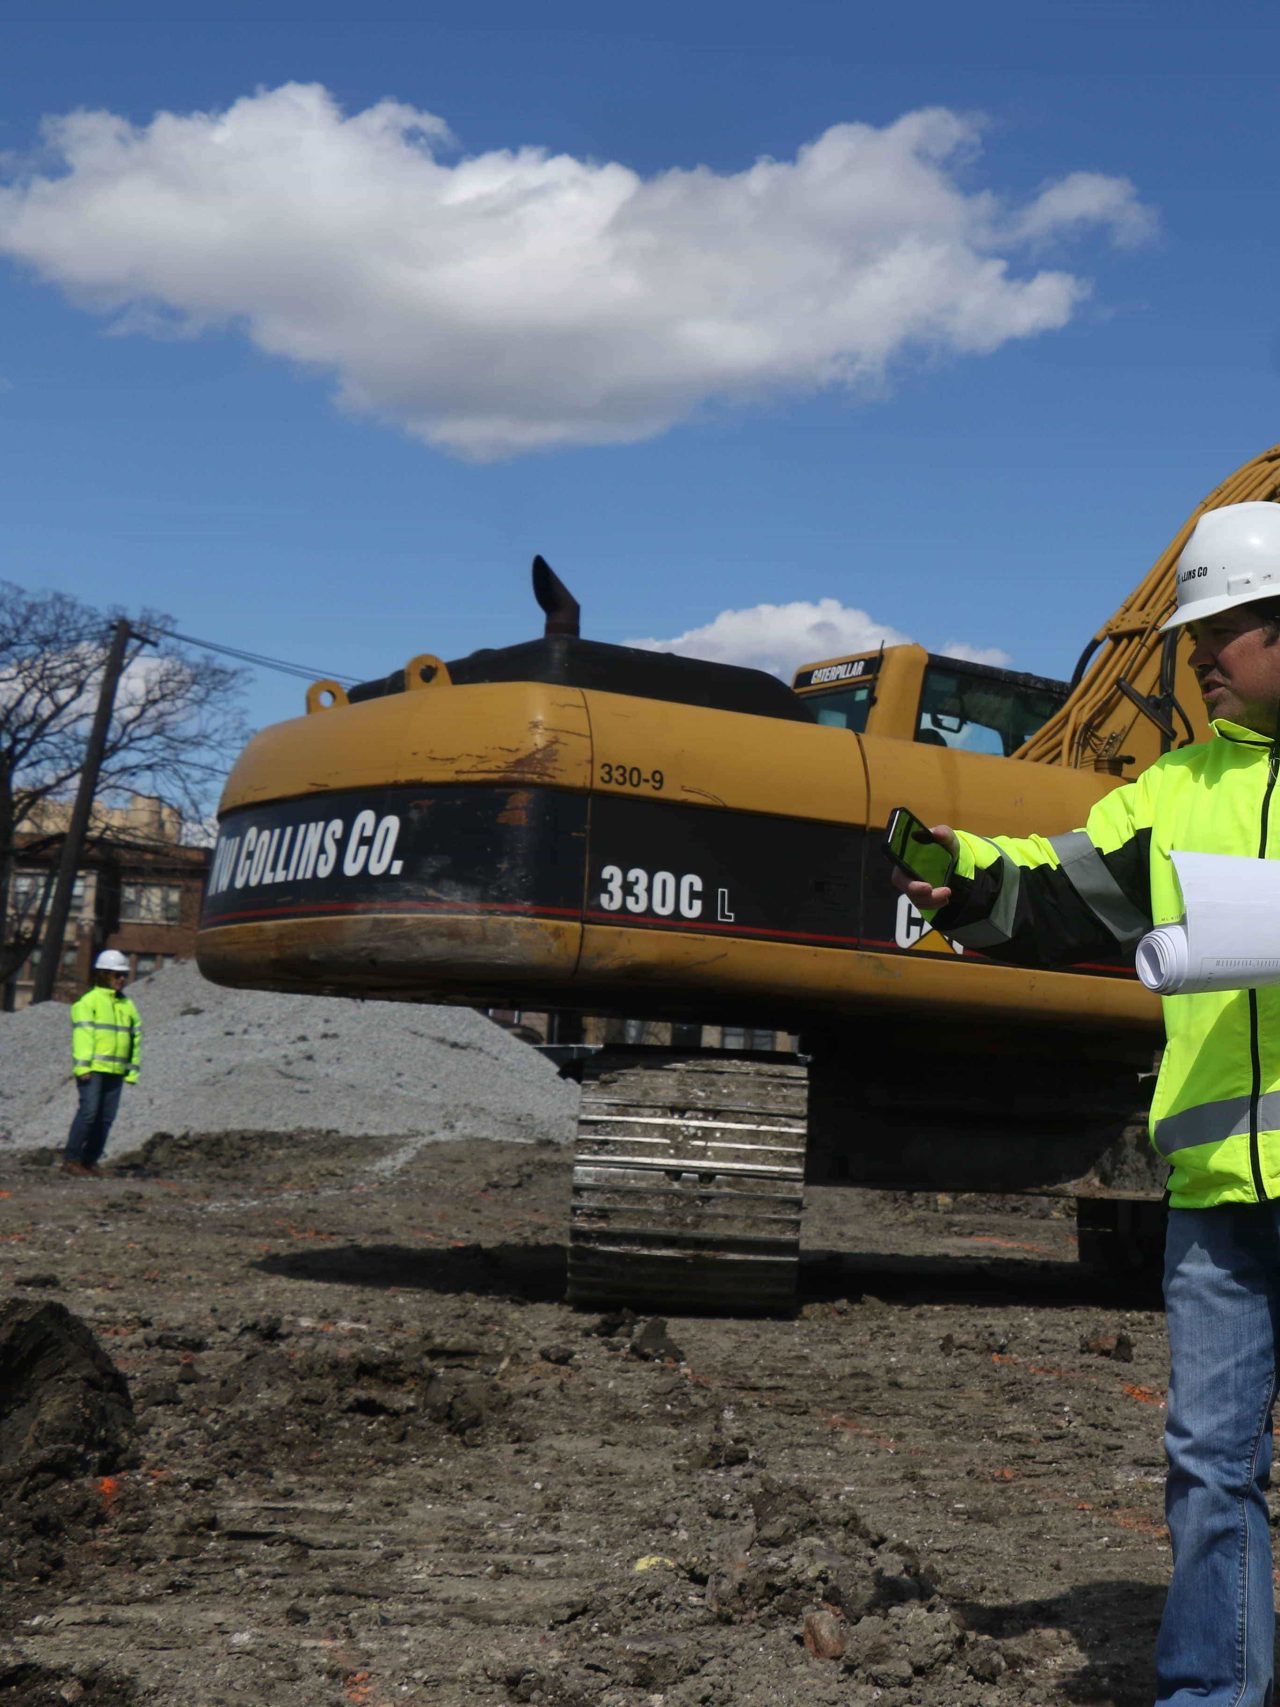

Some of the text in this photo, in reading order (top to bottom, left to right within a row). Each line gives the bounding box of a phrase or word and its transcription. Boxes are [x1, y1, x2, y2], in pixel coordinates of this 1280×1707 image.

[1197, 566, 1208, 578] CO
[810, 660, 865, 684] CATERPILLAR
[600, 762, 664, 791] 330-9
[207, 809, 404, 897] RW COLLINS CO.
[600, 865, 735, 922] 330C L
